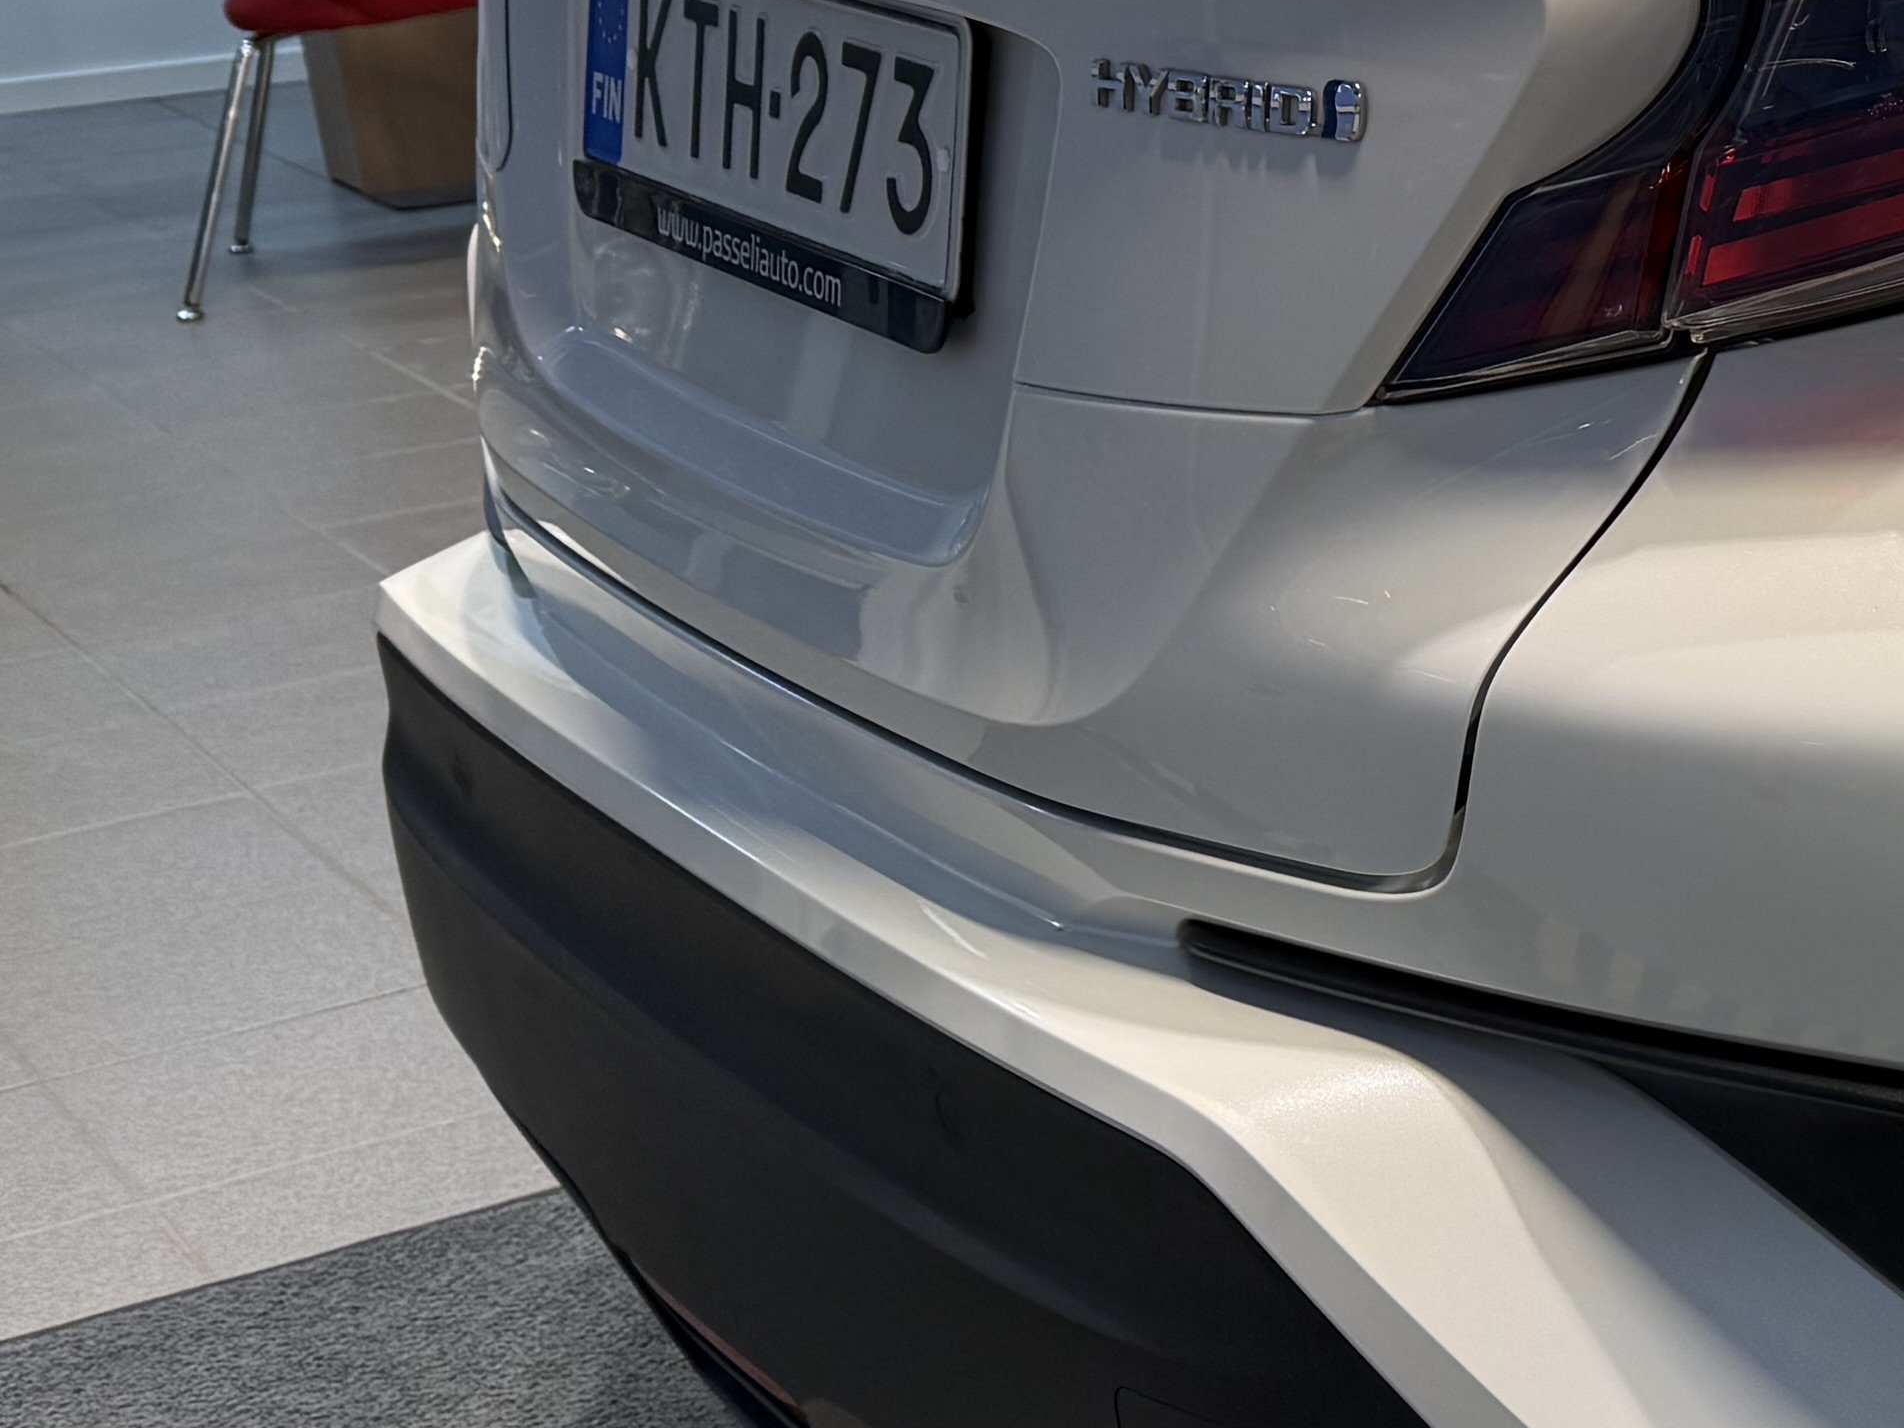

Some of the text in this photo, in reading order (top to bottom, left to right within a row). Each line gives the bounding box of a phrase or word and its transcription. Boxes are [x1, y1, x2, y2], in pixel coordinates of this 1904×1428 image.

[592, 72, 623, 123] FIN
[1090, 57, 1318, 136] HYBRID
[657, 206, 842, 307] www.passeliauto.com
